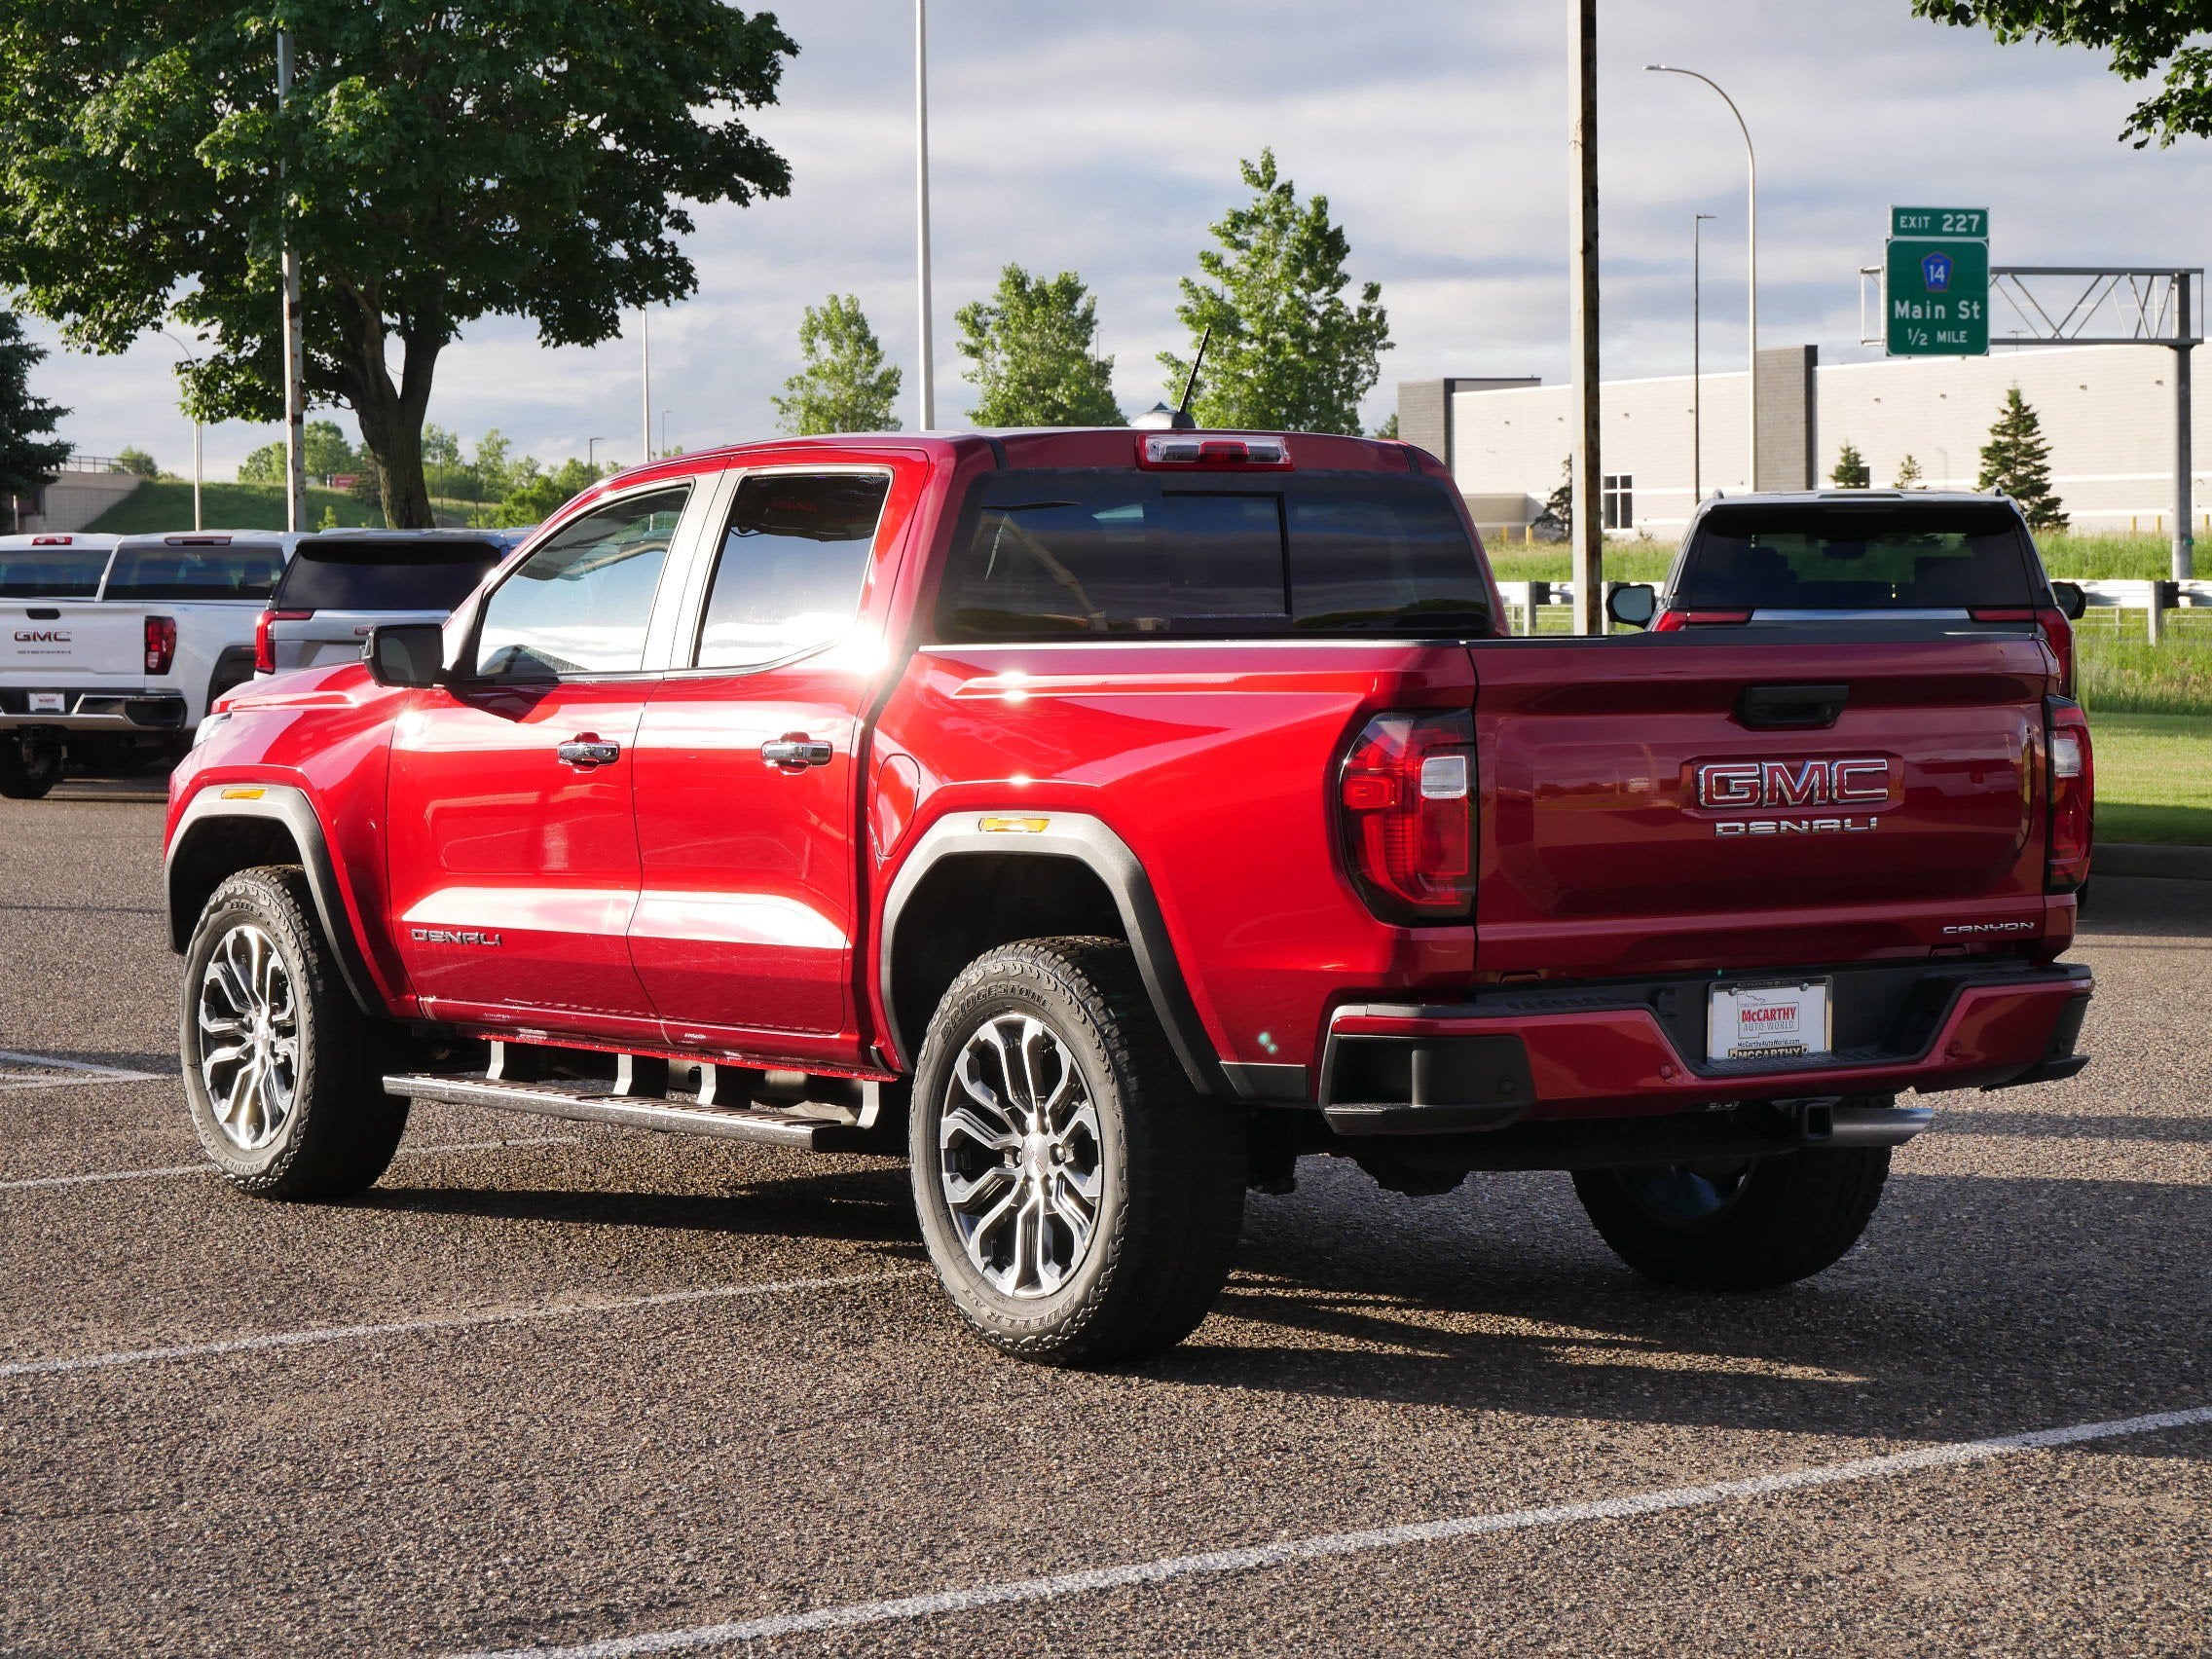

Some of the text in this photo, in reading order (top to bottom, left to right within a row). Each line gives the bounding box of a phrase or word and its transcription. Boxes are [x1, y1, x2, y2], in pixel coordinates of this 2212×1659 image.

[1899, 213, 1980, 233] EXIT 227
[1929, 264, 1945, 283] 14
[1895, 300, 1980, 320] Main St
[1936, 330, 1968, 344] MILE
[14, 631, 72, 643] GMC
[1698, 758, 1889, 807] GMC
[1714, 816, 1878, 836] DENALI
[1942, 921, 2035, 934] CANYON
[411, 929, 502, 945] DENALI
[940, 980, 1053, 1045] BRIDGESTONE
[1741, 1006, 1797, 1023] McCARTHY
[1743, 1020, 1794, 1032] AUTO WORLD
